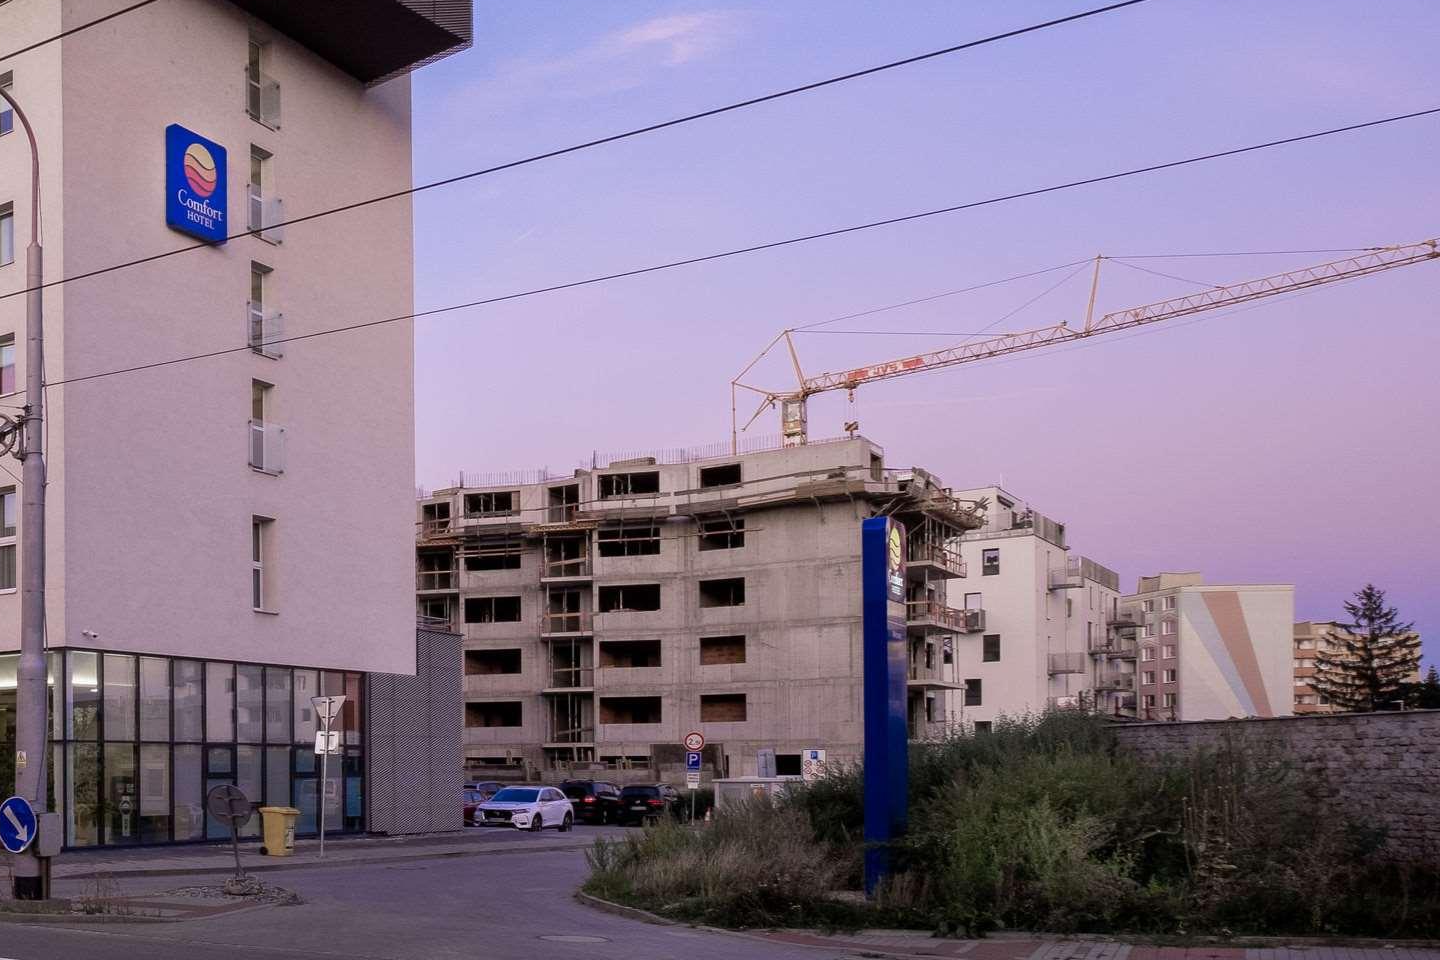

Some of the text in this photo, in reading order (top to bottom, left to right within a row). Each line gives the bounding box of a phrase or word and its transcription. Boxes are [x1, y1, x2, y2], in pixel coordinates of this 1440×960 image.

[177, 188, 224, 222] Comfort
[187, 210, 215, 229] HOTEL
[689, 753, 698, 765] P
